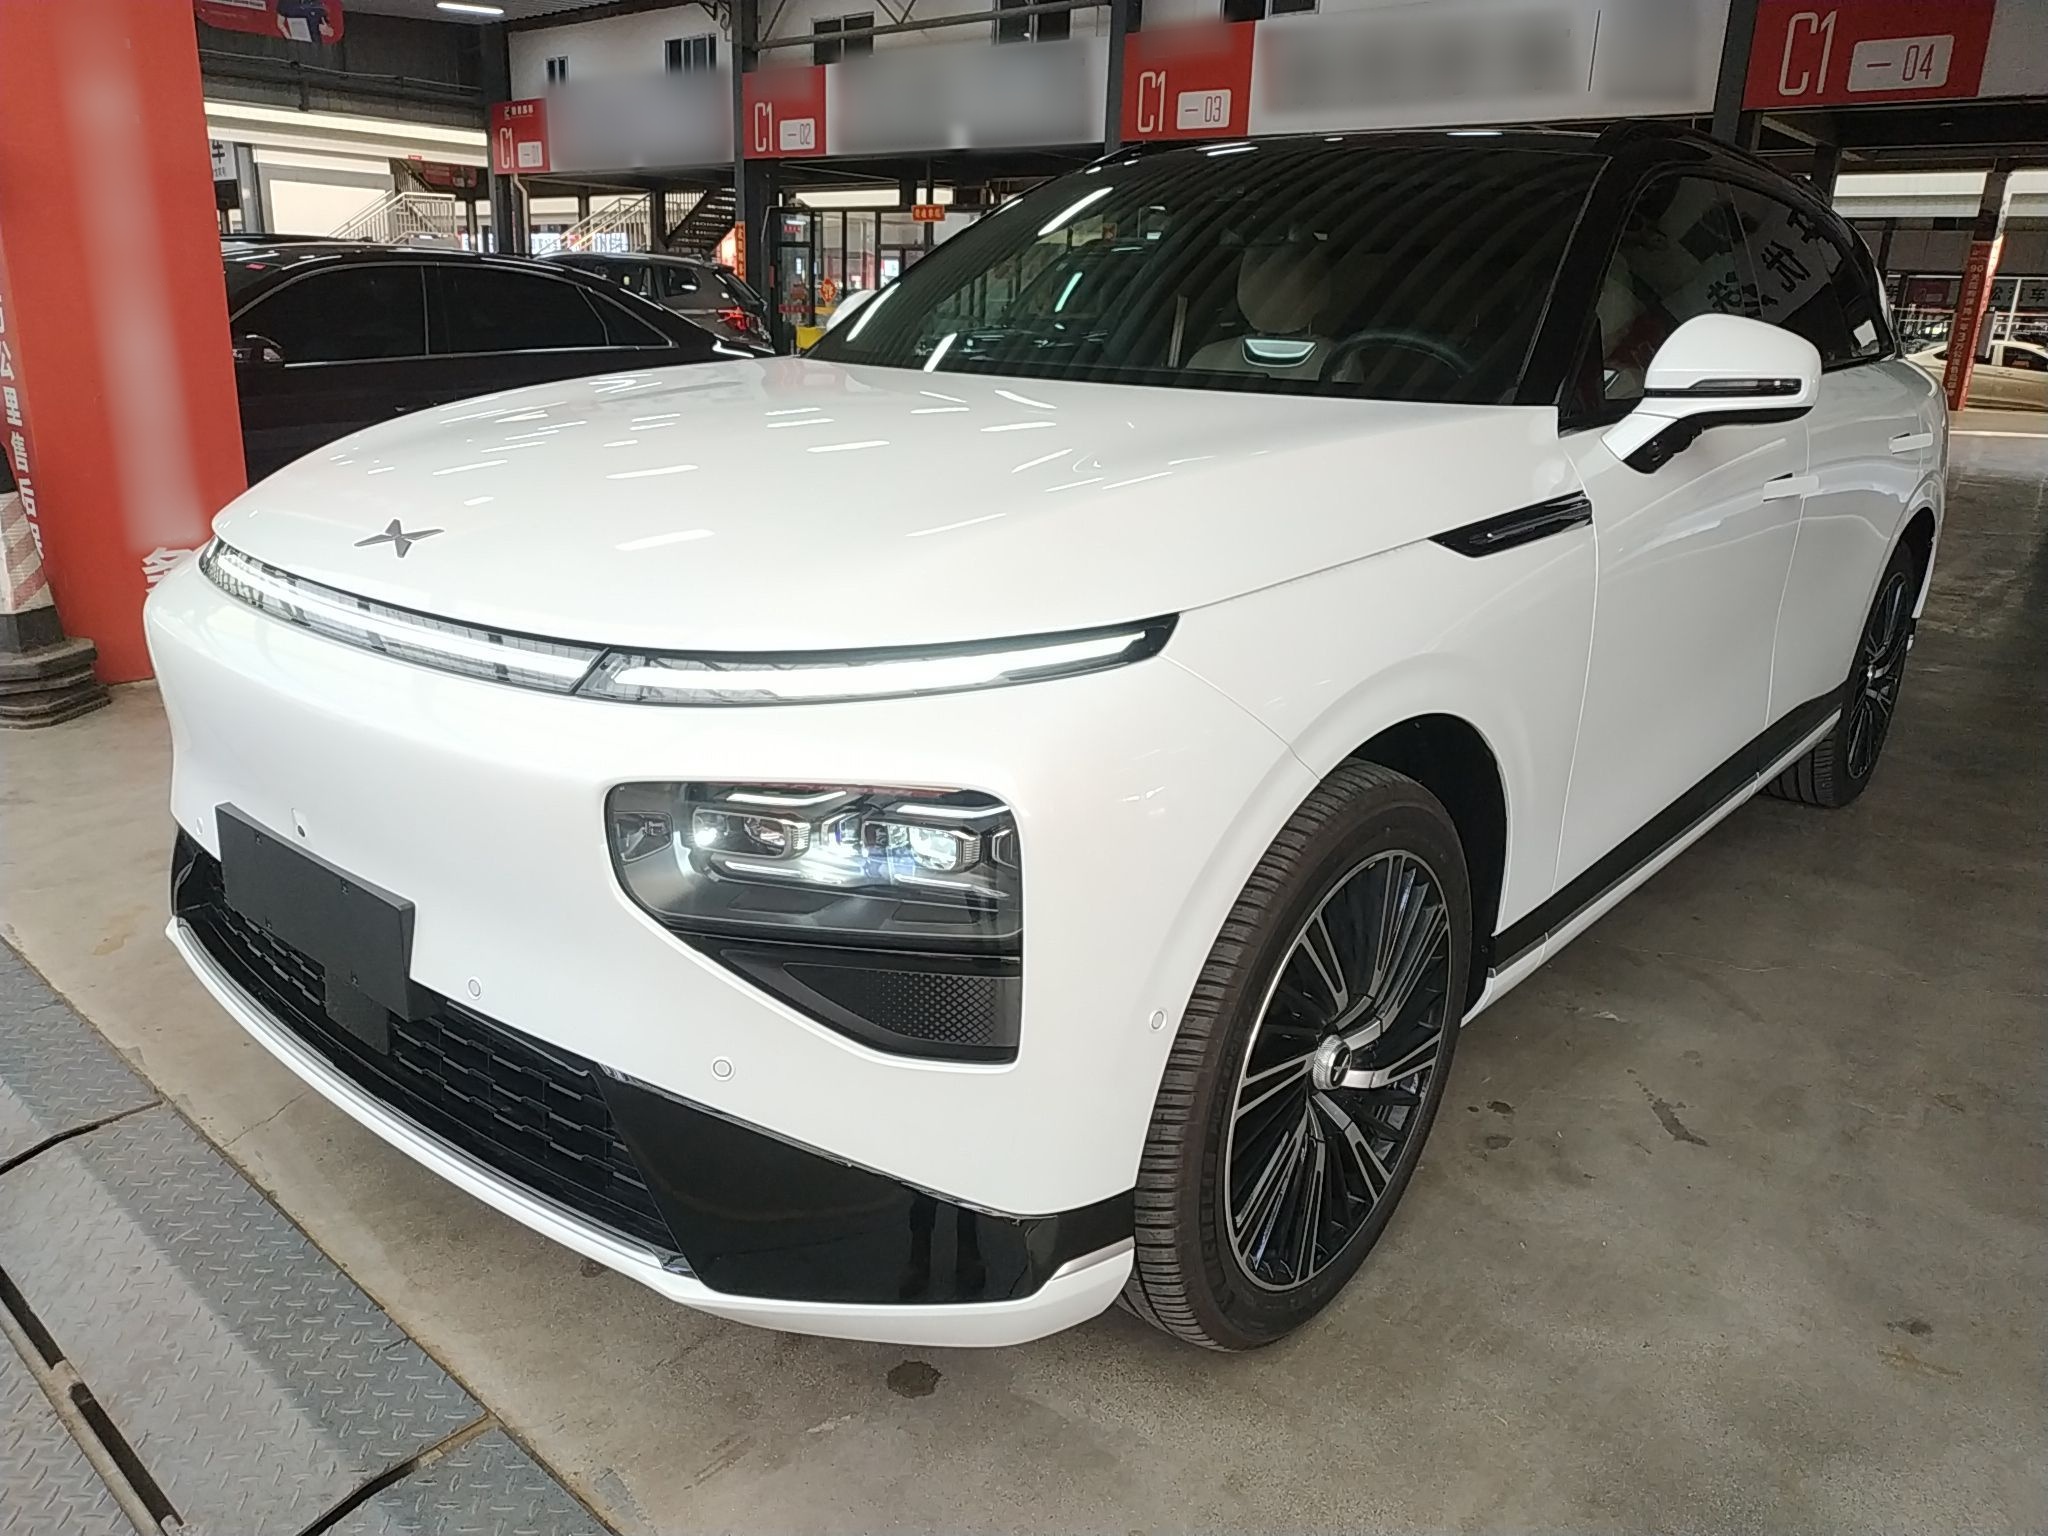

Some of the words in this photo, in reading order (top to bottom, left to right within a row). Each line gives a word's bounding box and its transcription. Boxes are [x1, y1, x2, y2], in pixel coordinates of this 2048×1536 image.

[1778, 9, 1839, 96] C1
[754, 101, 773, 152] C1
[1137, 70, 1166, 133] C1
[499, 127, 515, 169] C1
